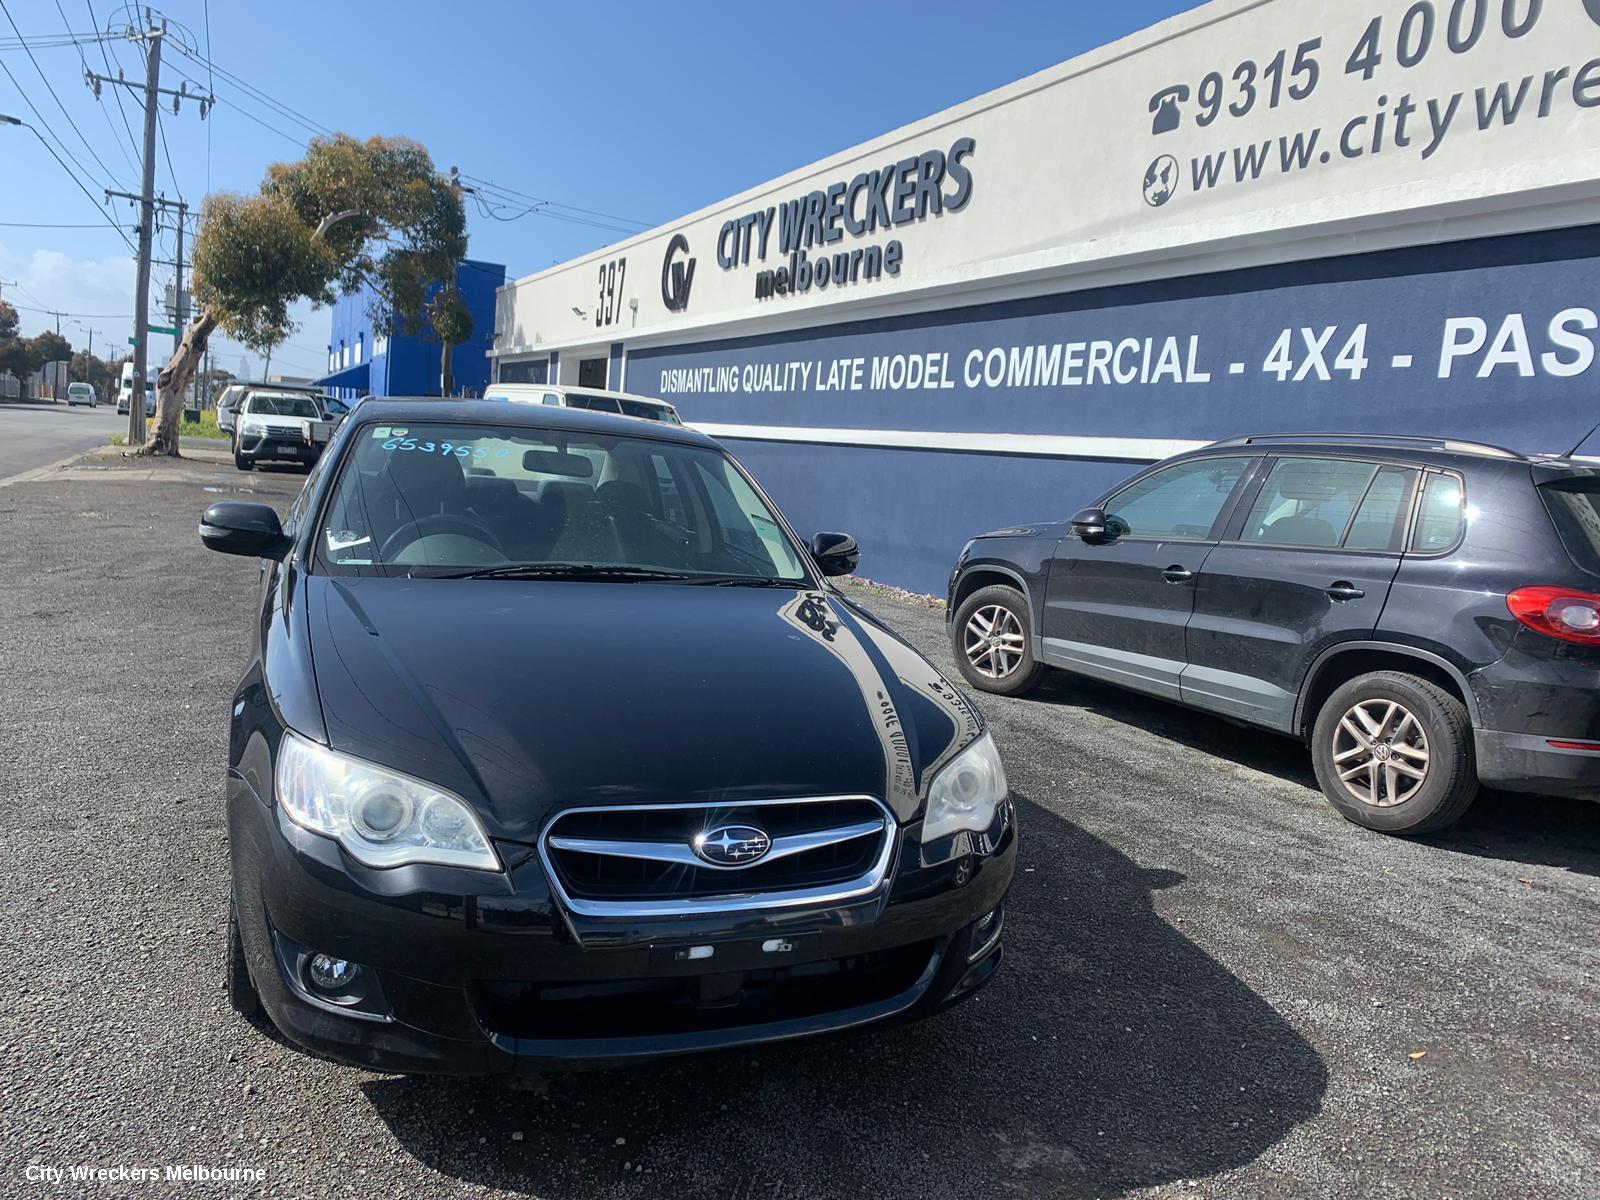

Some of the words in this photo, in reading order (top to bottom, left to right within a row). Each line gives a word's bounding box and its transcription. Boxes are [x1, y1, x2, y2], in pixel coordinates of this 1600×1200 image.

[1195, 36, 1323, 128] 9315
[1344, 0, 1543, 81] 4000
[716, 206, 776, 271] CITY
[779, 137, 976, 255] WRECKERS
[595, 257, 627, 328] 397
[755, 238, 904, 301] melbourne
[660, 367, 739, 393] DISMANTLING
[742, 361, 812, 394] QUALITY
[815, 357, 865, 391] LATE
[870, 352, 955, 390] MODEL
[963, 334, 1212, 389] COMMERCIAL
[1262, 323, 1369, 382] 4X4
[1437, 307, 1598, 379] PAS
